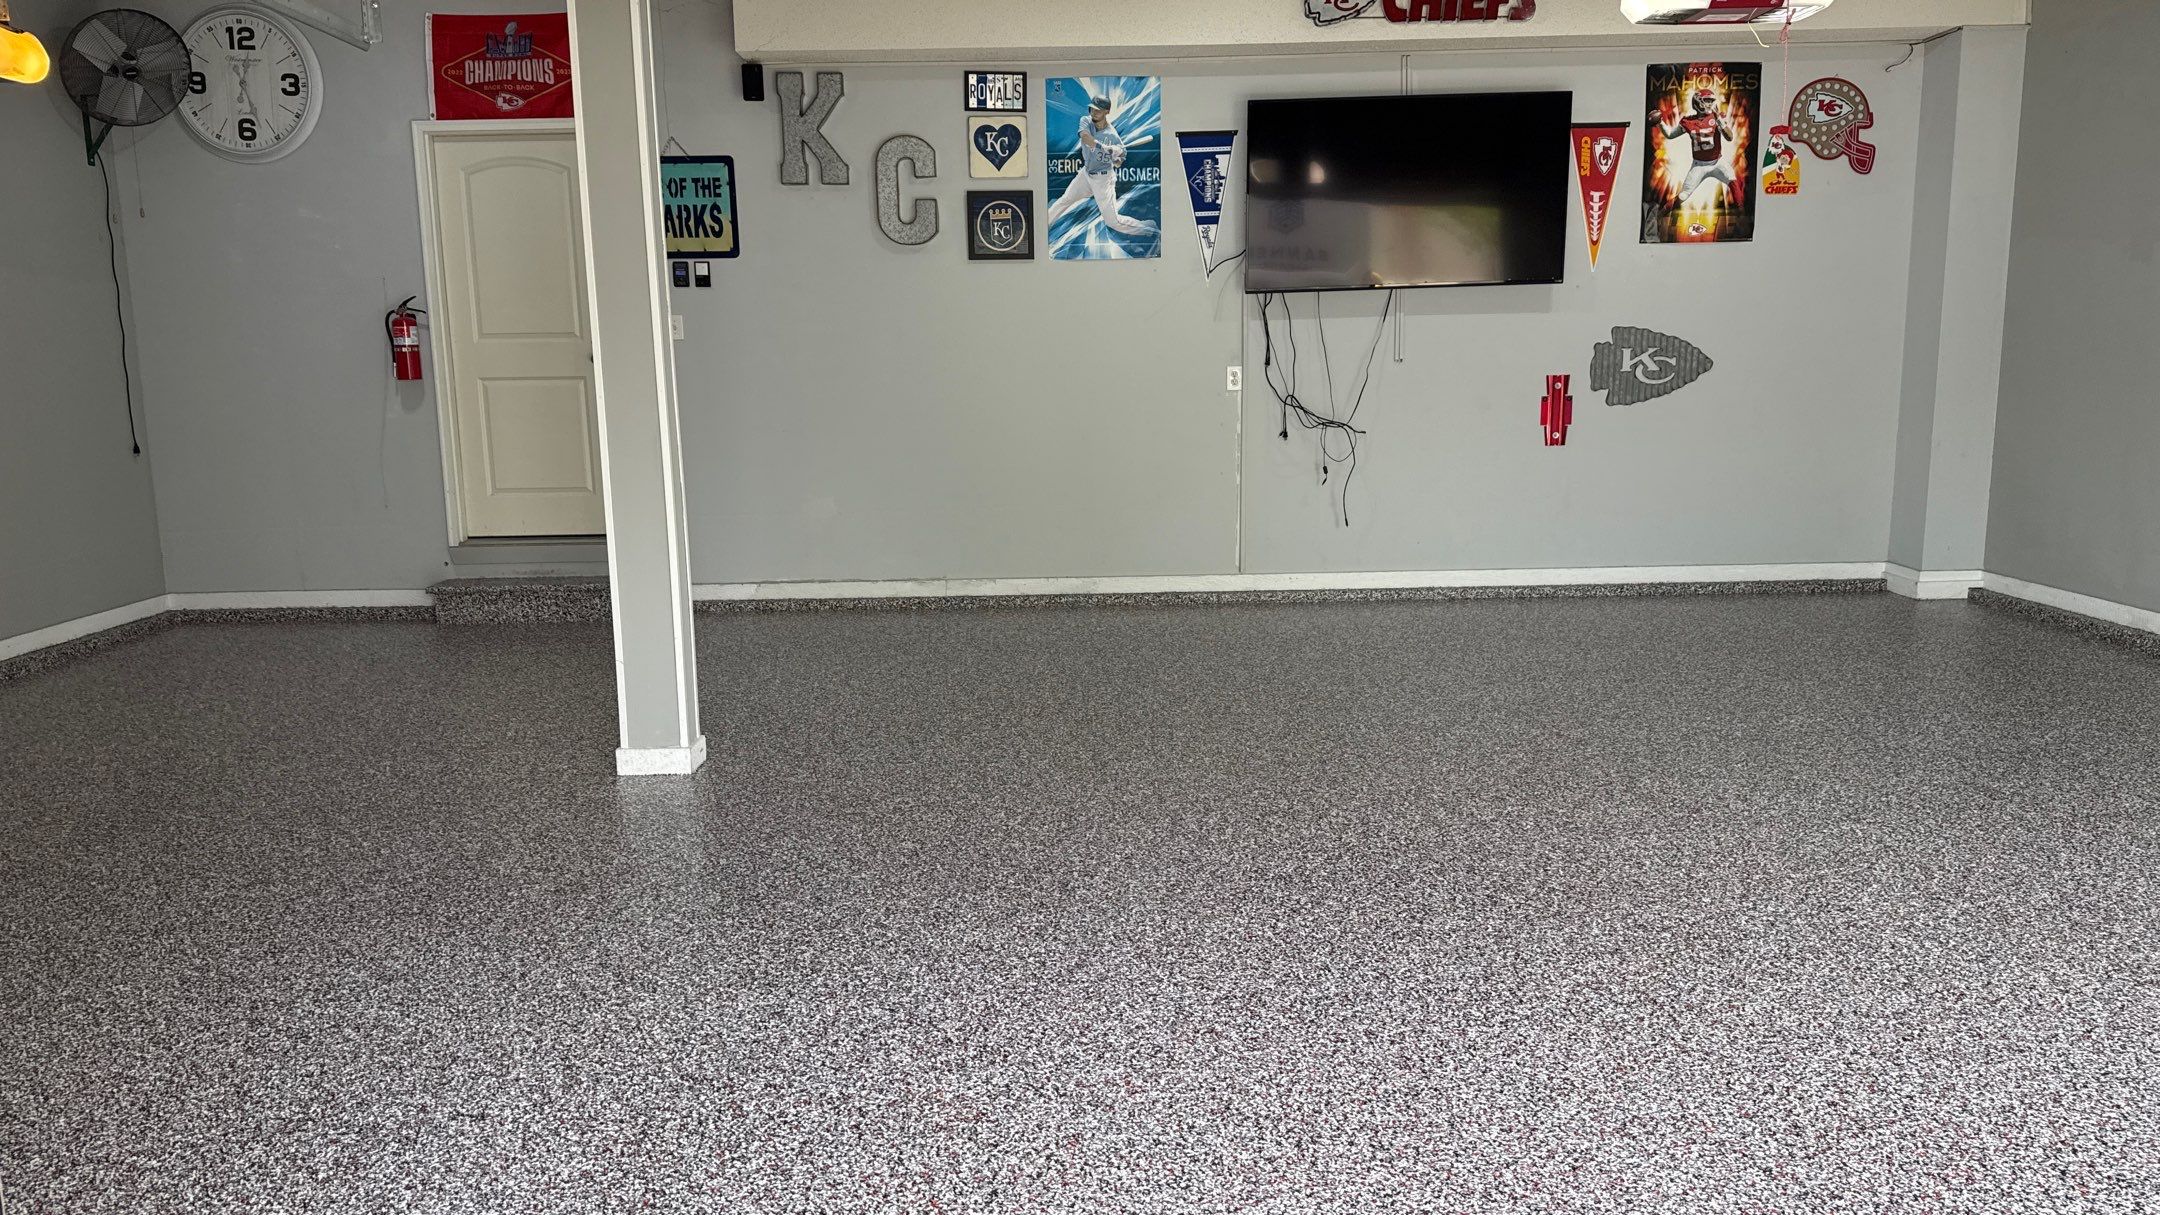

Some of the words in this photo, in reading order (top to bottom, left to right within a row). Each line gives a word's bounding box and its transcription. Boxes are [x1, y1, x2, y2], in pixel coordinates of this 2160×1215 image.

[225, 26, 256, 50] 12
[188, 72, 206, 94] 9
[464, 58, 555, 86] CHAMPIONS
[1650, 74, 1760, 92] MAHOMES
[280, 73, 300, 96] 3
[969, 83, 1022, 103] ROYALS
[1817, 99, 1844, 117] KC
[237, 118, 257, 141] 6
[985, 131, 1009, 157] KC
[1058, 159, 1082, 173] ERIC
[1580, 136, 1592, 177] CHIEFS
[1114, 167, 1160, 182] HOSMER
[1203, 159, 1212, 204] CHAMPIONS
[667, 177, 687, 198] OF
[691, 177, 722, 198] THE
[993, 221, 1010, 240] KC
[1620, 347, 1677, 385] KC
